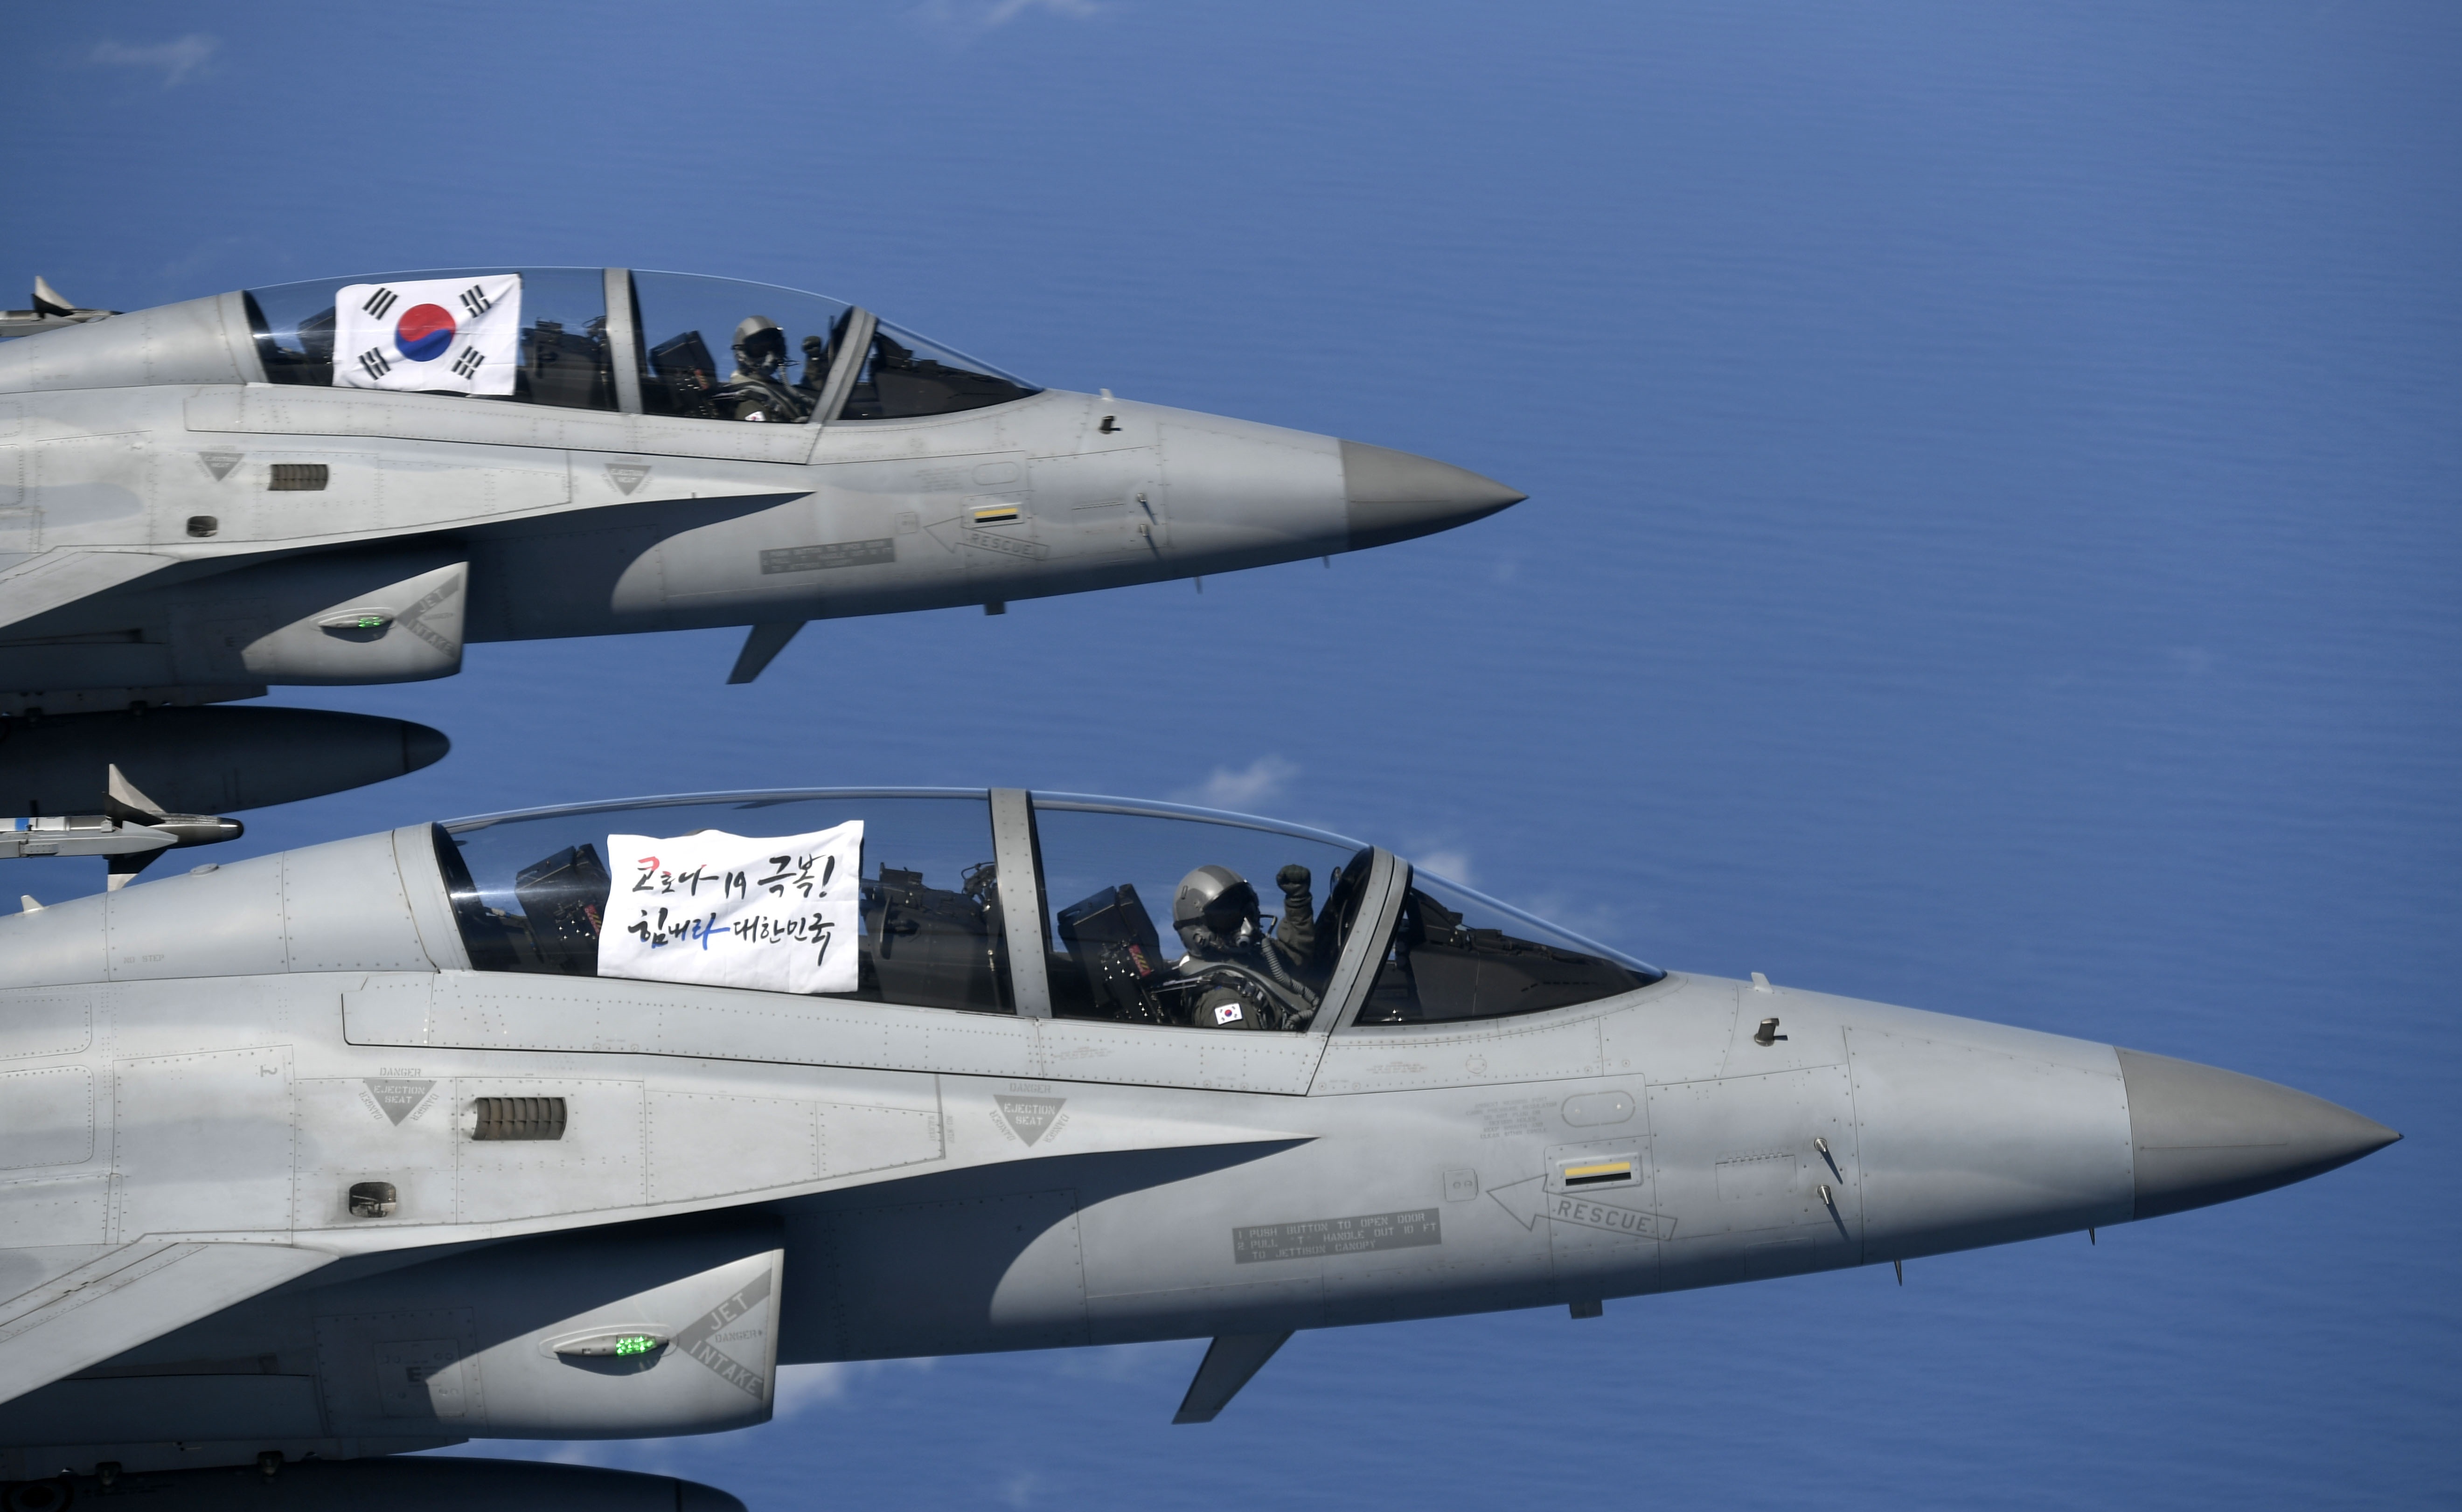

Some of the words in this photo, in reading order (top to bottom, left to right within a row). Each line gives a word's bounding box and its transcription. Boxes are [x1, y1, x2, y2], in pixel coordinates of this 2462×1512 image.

[970, 534, 1034, 555] RESCUE
[420, 588, 444, 613] JET
[757, 853, 835, 898] 극복!
[627, 907, 730, 950] 힘내라
[734, 912, 835, 966] 대한민국
[142, 954, 164, 963] STEP
[379, 1067, 421, 1077] DANGER
[374, 1085, 426, 1095] EJECTION
[1009, 1082, 1051, 1094] DANGER
[358, 1091, 383, 1120] DANGER
[385, 1096, 412, 1104] SEAT
[410, 1093, 440, 1121] DANGER
[1004, 1103, 1056, 1115] EJECTION
[1015, 1116, 1043, 1125] SEAT
[1249, 1228, 1278, 1238] PUSH
[1286, 1222, 1328, 1235] BUTTON
[1337, 1221, 1351, 1230] TO
[1360, 1216, 1389, 1228] OPEN
[1397, 1212, 1426, 1224] DOOR
[1557, 1200, 1652, 1232] RESCUE
[1237, 1241, 1245, 1251] 2
[1250, 1239, 1279, 1249] PULL
[1323, 1230, 1365, 1243] HANDLE
[1374, 1227, 1395, 1238] OUT
[1404, 1225, 1414, 1235] 10
[1423, 1223, 1437, 1233] FT
[1252, 1251, 1266, 1260] TO
[1275, 1245, 1326, 1259] JETTISON
[1335, 1239, 1377, 1253] CANOPY
[711, 1292, 747, 1330] JET
[715, 1330, 757, 1344] DANGER
[406, 1366, 421, 1382] E
[690, 1340, 764, 1394] INTAKE
